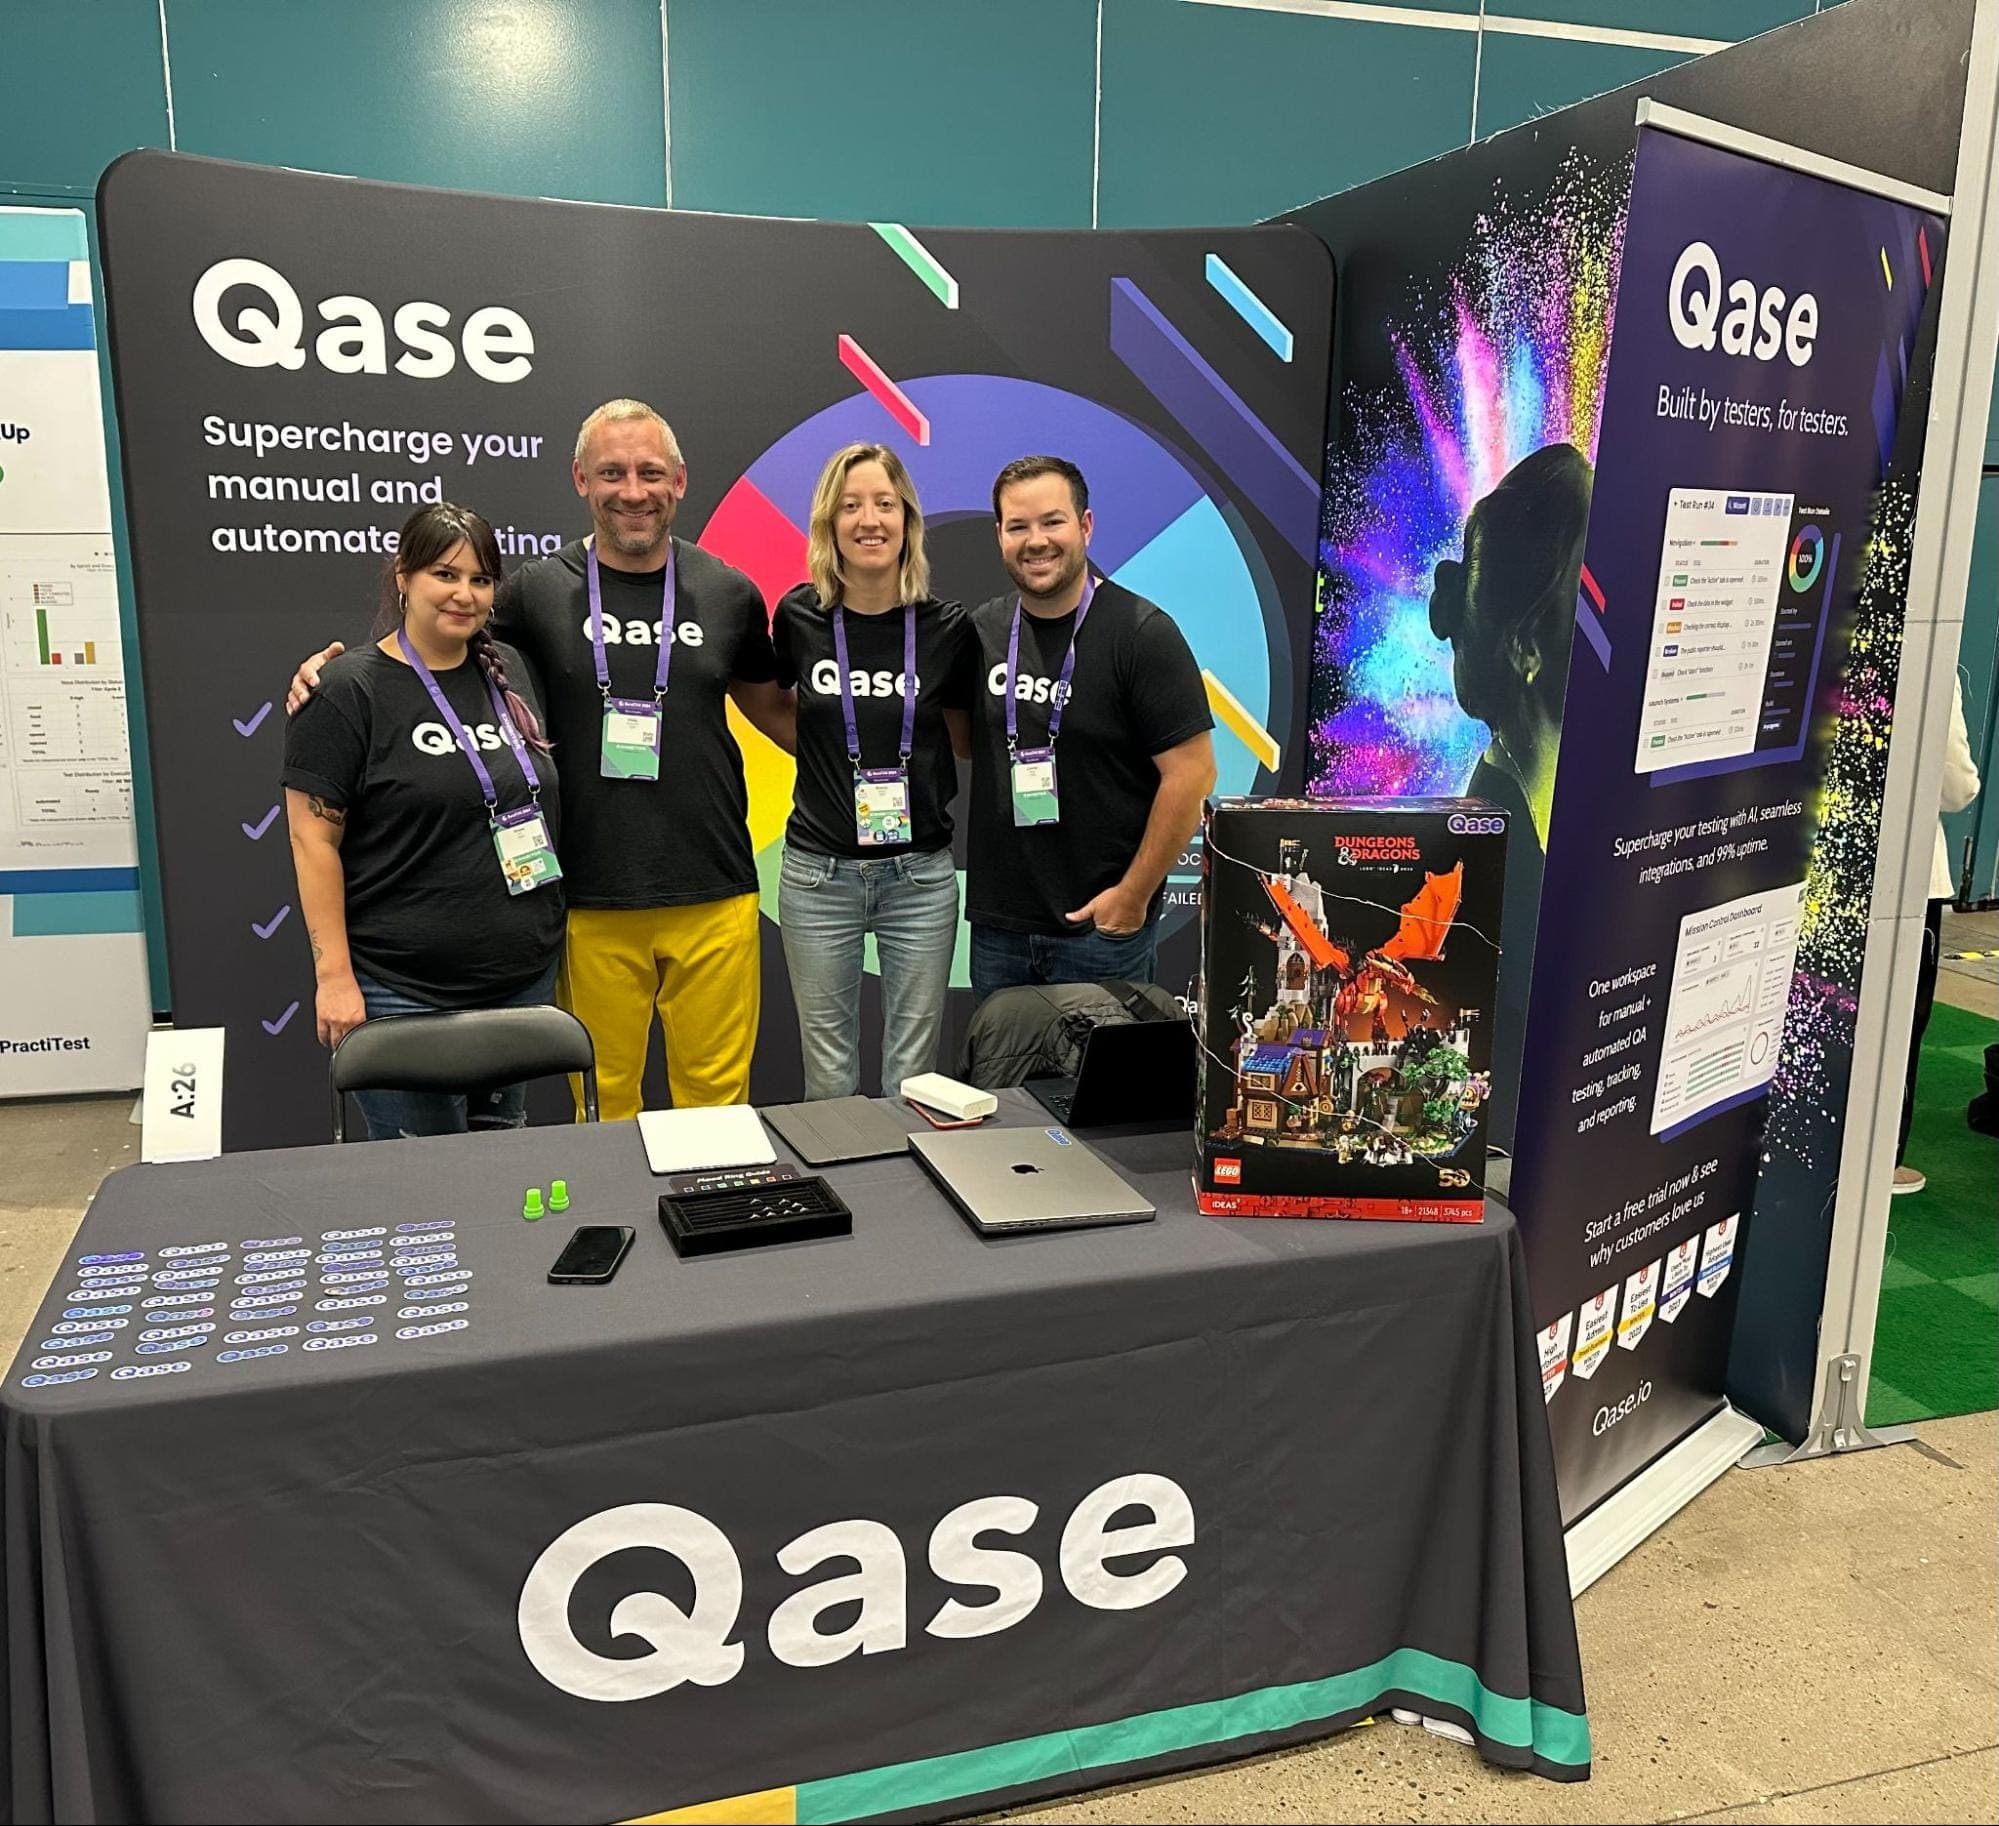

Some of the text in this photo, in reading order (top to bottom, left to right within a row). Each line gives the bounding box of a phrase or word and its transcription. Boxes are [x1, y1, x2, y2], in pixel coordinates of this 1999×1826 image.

[1668, 242, 1819, 367] Qase
[193, 258, 535, 384] Qase
[1657, 385, 1849, 436] Built by testers, for testers.
[0, 423, 30, 444] Up
[203, 415, 543, 465] Supercharge your
[207, 473, 442, 505] manual and
[211, 524, 561, 560] automate ting
[1449, 815, 1504, 834] Qase
[1613, 799, 1802, 859] Supercharge your testing with AI, seamless
[1334, 836, 1415, 848] DUNGEONS
[1350, 848, 1421, 860] DRAGONS
[1639, 837, 1768, 884] integrations, and 99% uptime.
[1685, 921, 1709, 937] Mission
[1709, 915, 1729, 930] Control
[1589, 980, 1610, 999] One
[1611, 963, 1657, 992] workspace
[1598, 1012, 1612, 1029] for
[1612, 994, 1645, 1019] manual
[0, 1036, 91, 1053] PractiTest
[1582, 1026, 1647, 1068] automated QA
[169, 1062, 197, 1119] A:26
[1572, 1078, 1605, 1104] testing,
[1577, 1094, 1637, 1134] and reporting.
[1215, 1165, 1238, 1177] LEGO
[1212, 1201, 1236, 1209] IDEAS
[1584, 1159, 1718, 1243] Start a free trial now & see
[1461, 1208, 1473, 1217] pcs
[322, 1228, 386, 1239] Qase
[1589, 1190, 1704, 1268] why customers love us
[390, 1233, 454, 1245] Qase
[159, 1243, 227, 1256] Qase
[244, 1250, 311, 1261] Qase
[316, 1251, 382, 1262] Qase
[390, 1254, 455, 1266] Qase
[78, 1265, 148, 1276] Qase
[153, 1268, 223, 1280] Qase
[235, 1269, 304, 1283] Qase
[321, 1272, 388, 1282] Qase
[405, 1271, 472, 1284] Qase
[68, 1287, 141, 1300] Qase
[142, 1293, 214, 1307] Qase
[231, 1292, 302, 1307] Qase
[1630, 1285, 1652, 1303] Easiest
[316, 1296, 386, 1310] Qase
[398, 1303, 468, 1318] Qase
[52, 1319, 128, 1332] Qase
[1585, 1311, 1608, 1330] Easiest
[139, 1324, 215, 1340] Qase
[225, 1327, 299, 1342] Qase
[396, 1321, 468, 1338] Qase
[303, 1335, 377, 1349] Qase
[32, 1352, 112, 1368] Qase
[111, 1362, 190, 1378] Qase
[1592, 1378, 1652, 1437] Qase.io
[518, 1473, 1196, 1701] Qase
